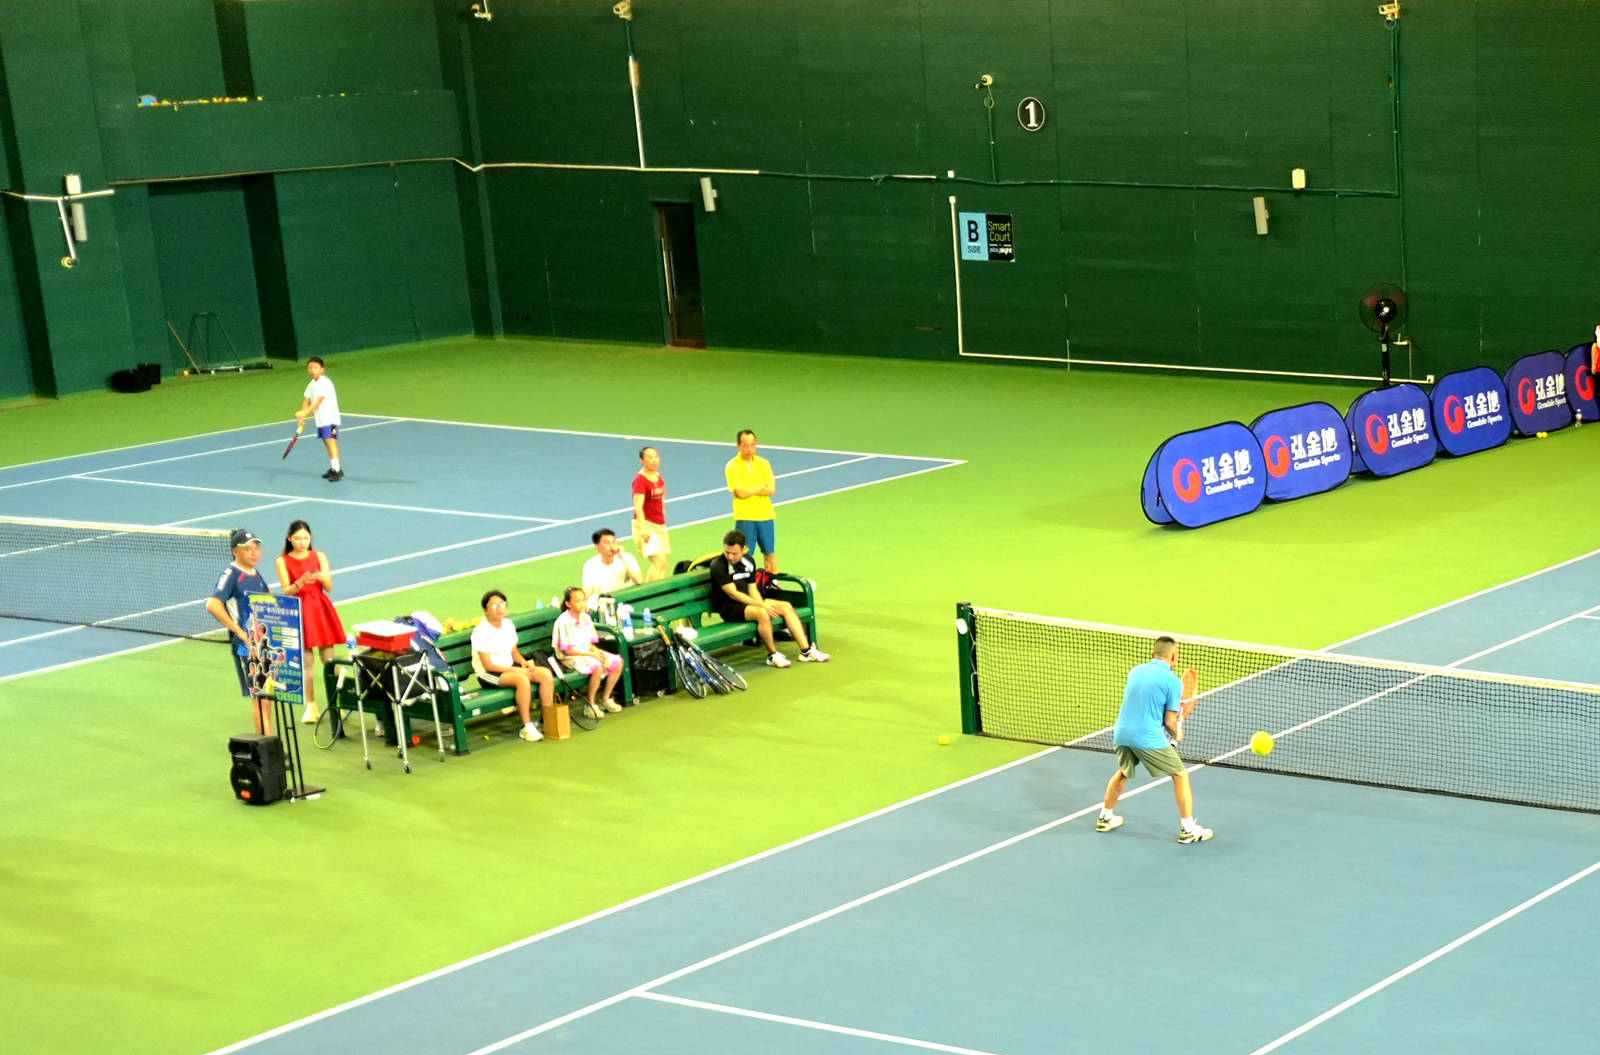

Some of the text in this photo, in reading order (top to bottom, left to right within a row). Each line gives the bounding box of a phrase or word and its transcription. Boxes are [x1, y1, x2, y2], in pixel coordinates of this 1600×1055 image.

[1025, 101, 1039, 128] 1
[967, 220, 979, 242] B
[987, 220, 1011, 232] Smart
[989, 230, 1011, 242] Court
[1464, 390, 1501, 419] 弘金地
[1387, 407, 1427, 439] 弘金地
[1290, 427, 1339, 461] 弘金地
[1201, 448, 1252, 486] 弘金地
